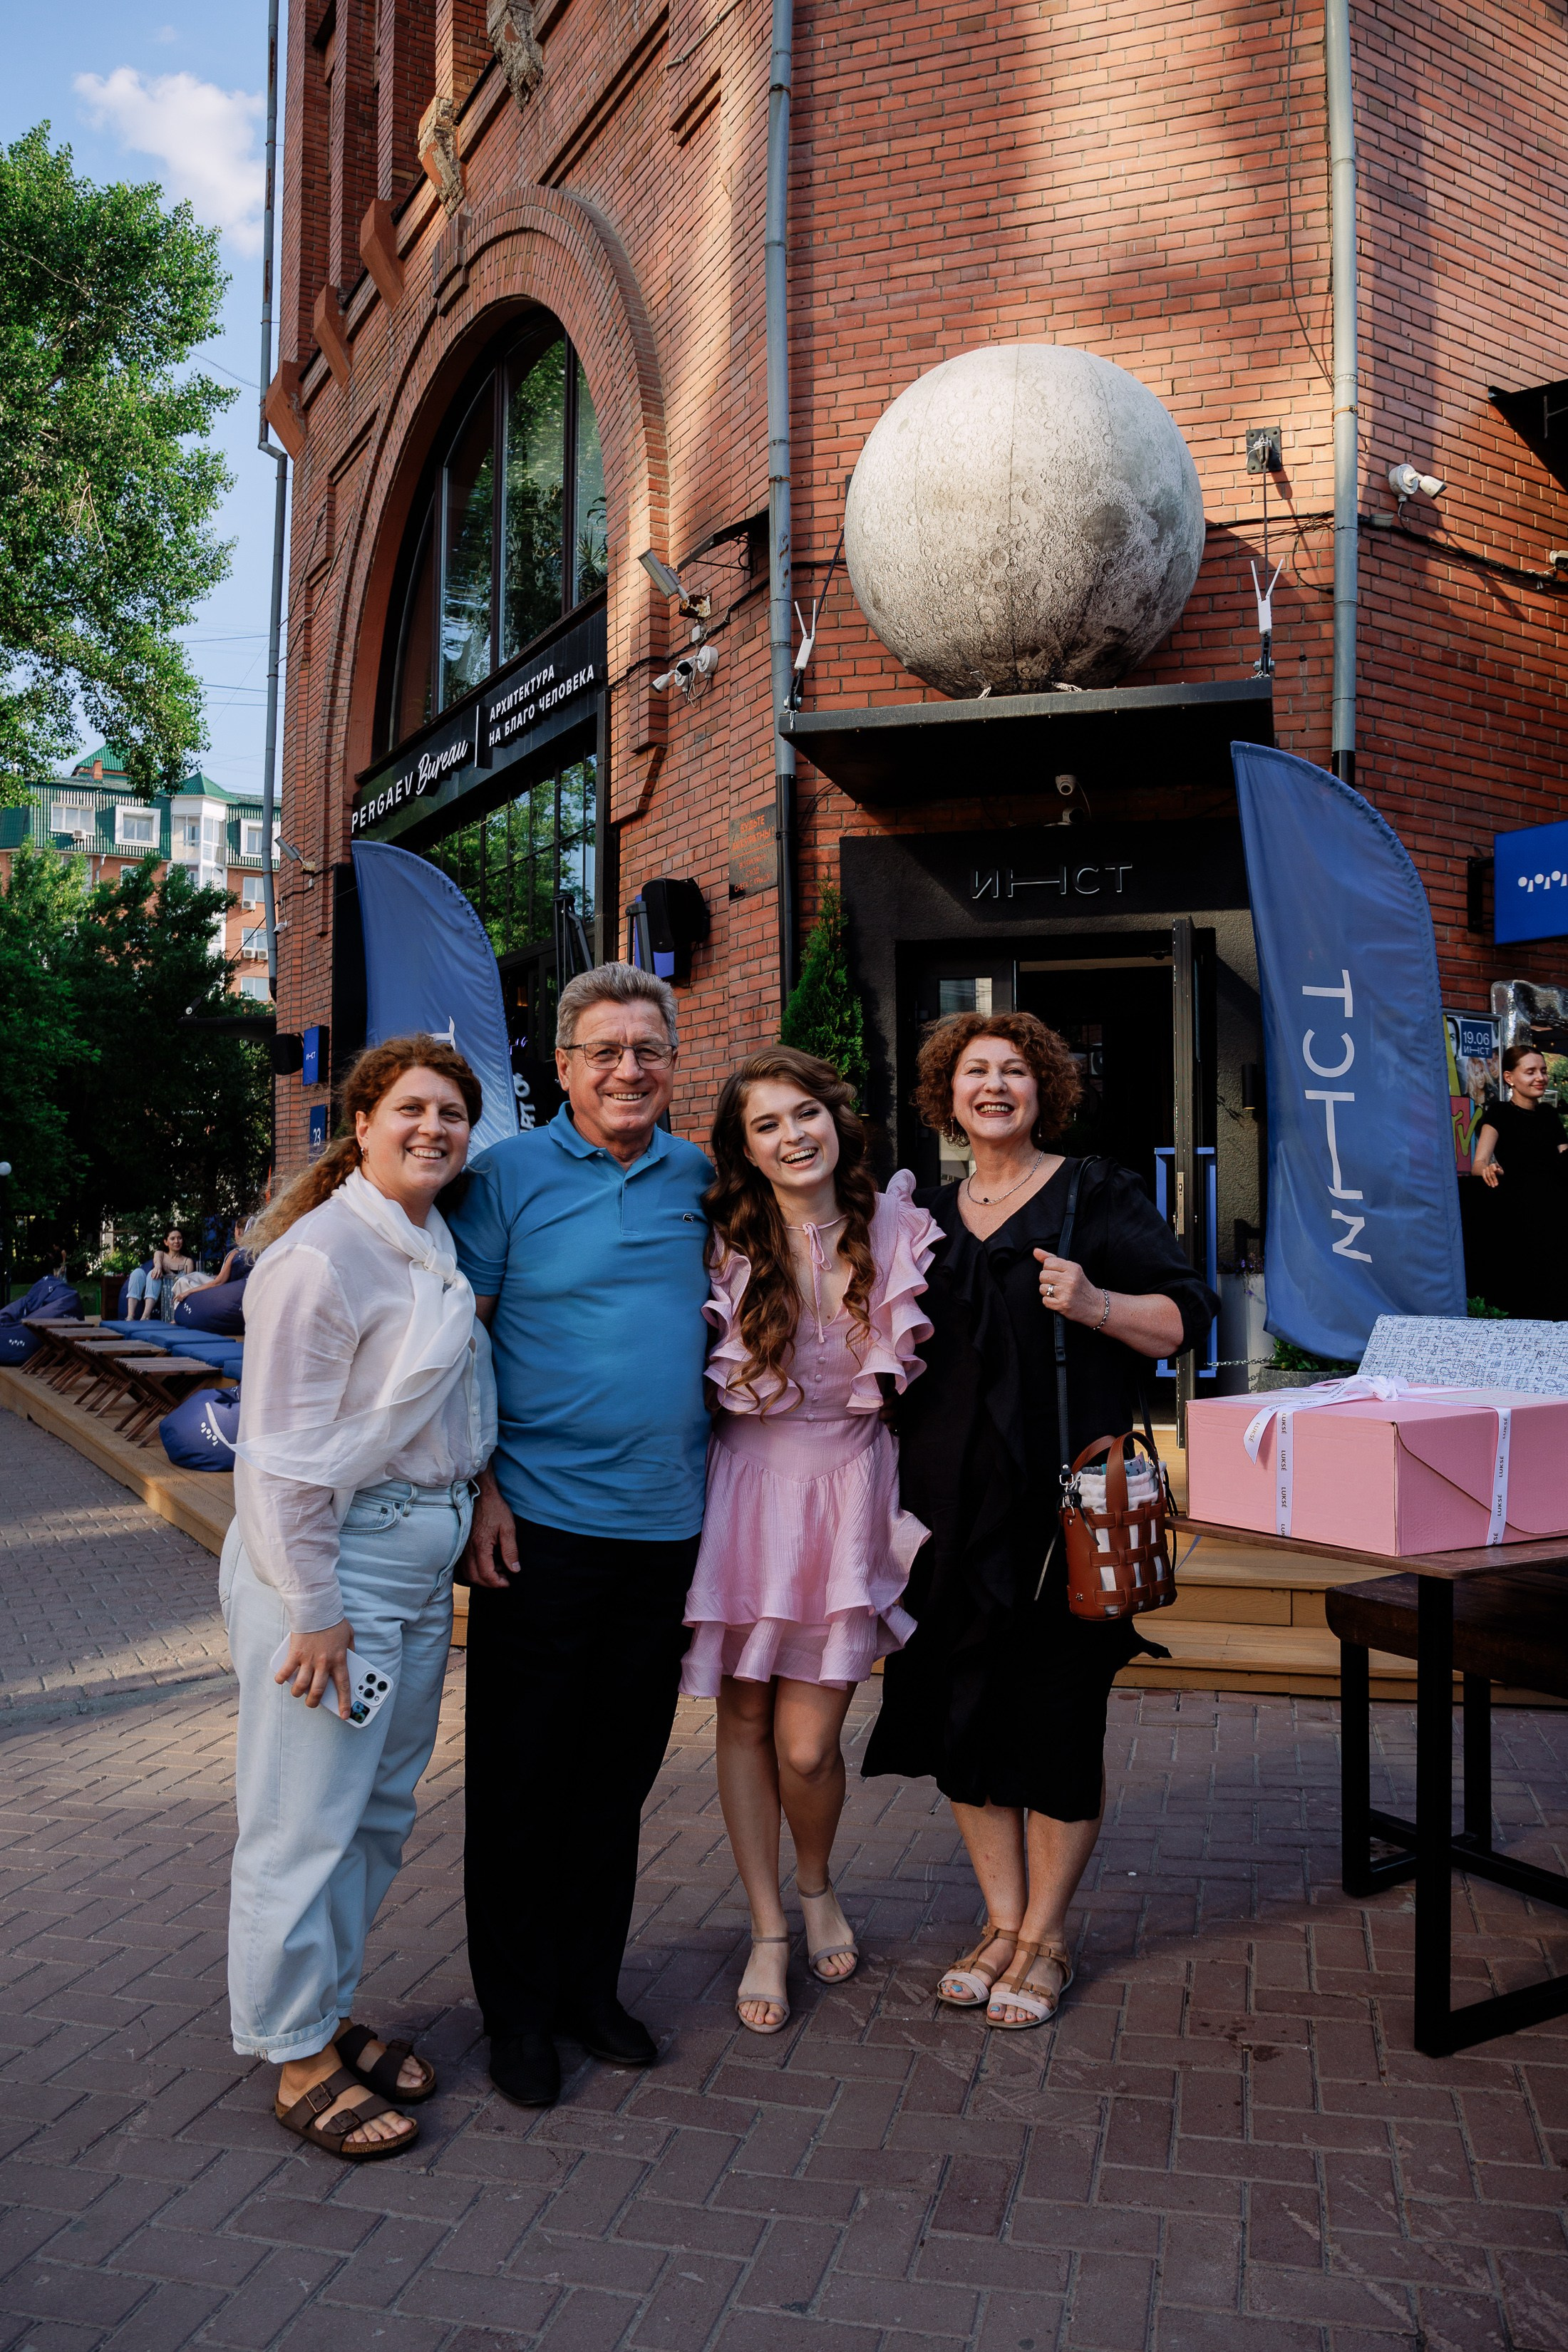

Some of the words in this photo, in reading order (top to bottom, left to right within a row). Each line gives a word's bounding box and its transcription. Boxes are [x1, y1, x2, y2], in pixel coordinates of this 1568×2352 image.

[488, 731, 501, 747] НА
[505, 704, 535, 737] БЛАГО
[539, 664, 594, 712] ЧЕЛОВЕКА
[489, 664, 555, 723] АРХИТЕКТУРА
[351, 771, 413, 833] PERGAEV
[416, 739, 468, 796] Bureau
[970, 862, 1133, 899] ИНСТ
[1463, 1031, 1490, 1046] 19.06
[313, 1128, 321, 1147] 23
[1302, 969, 1373, 1264] ИНСТ
[1249, 1422, 1260, 1443] LUKSÉ
